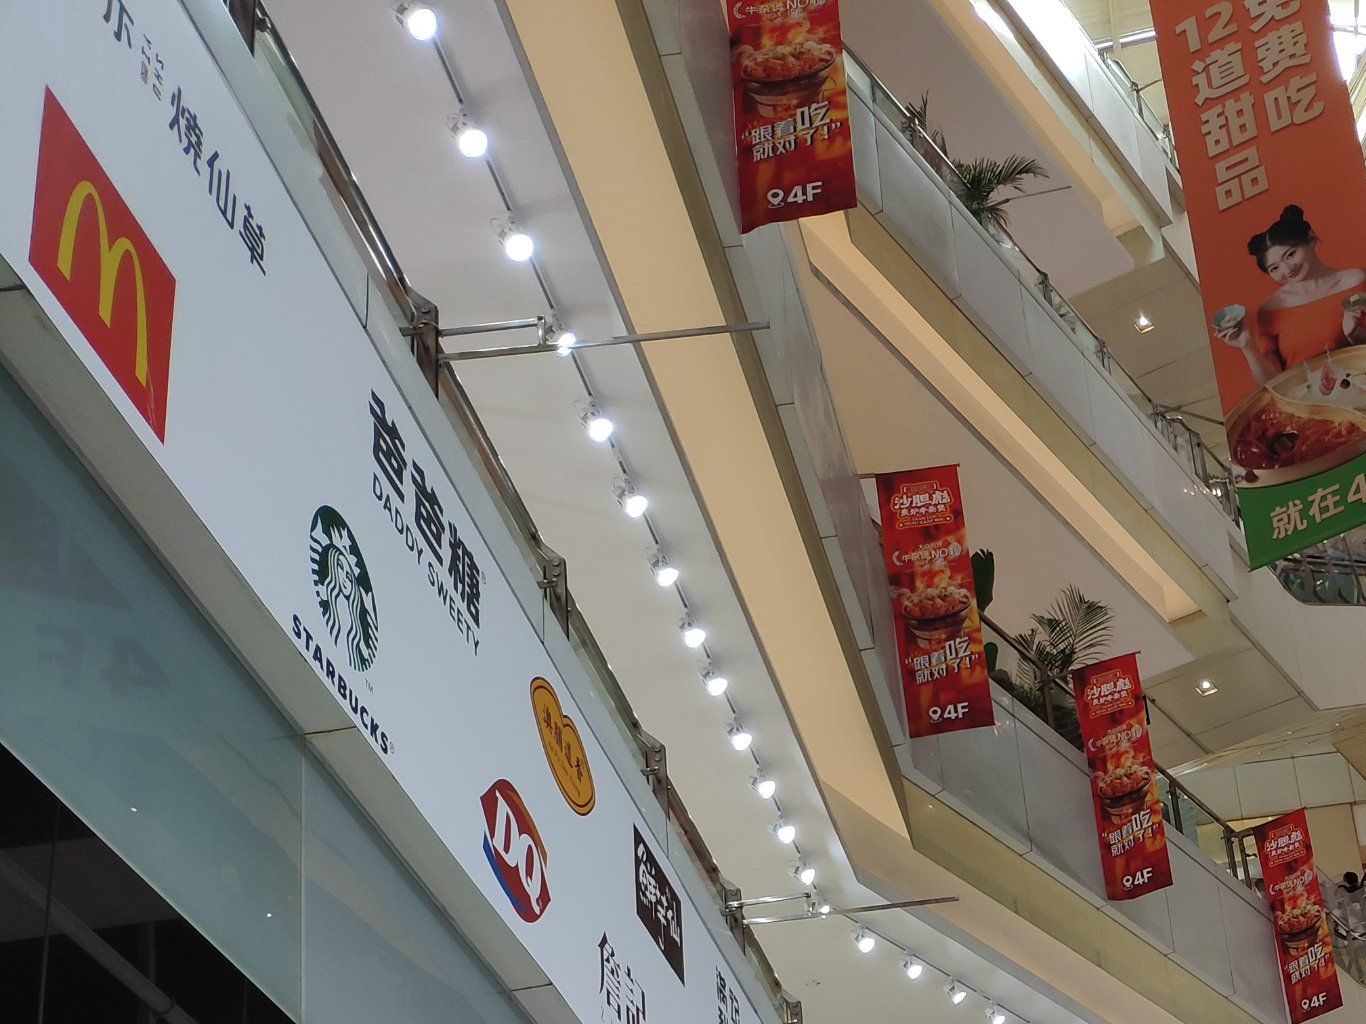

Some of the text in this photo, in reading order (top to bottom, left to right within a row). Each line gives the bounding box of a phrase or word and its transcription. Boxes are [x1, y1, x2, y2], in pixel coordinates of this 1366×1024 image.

[1175, 2, 1270, 212] 12道甜品
[787, 182, 823, 204] 4F
[371, 471, 481, 657] DADDY SWEETY
[291, 613, 392, 757] STARBUCKS
[943, 702, 969, 720] 4F
[490, 787, 547, 911] DQ
[1134, 868, 1153, 886] 4F
[1311, 992, 1327, 1008] 4F
